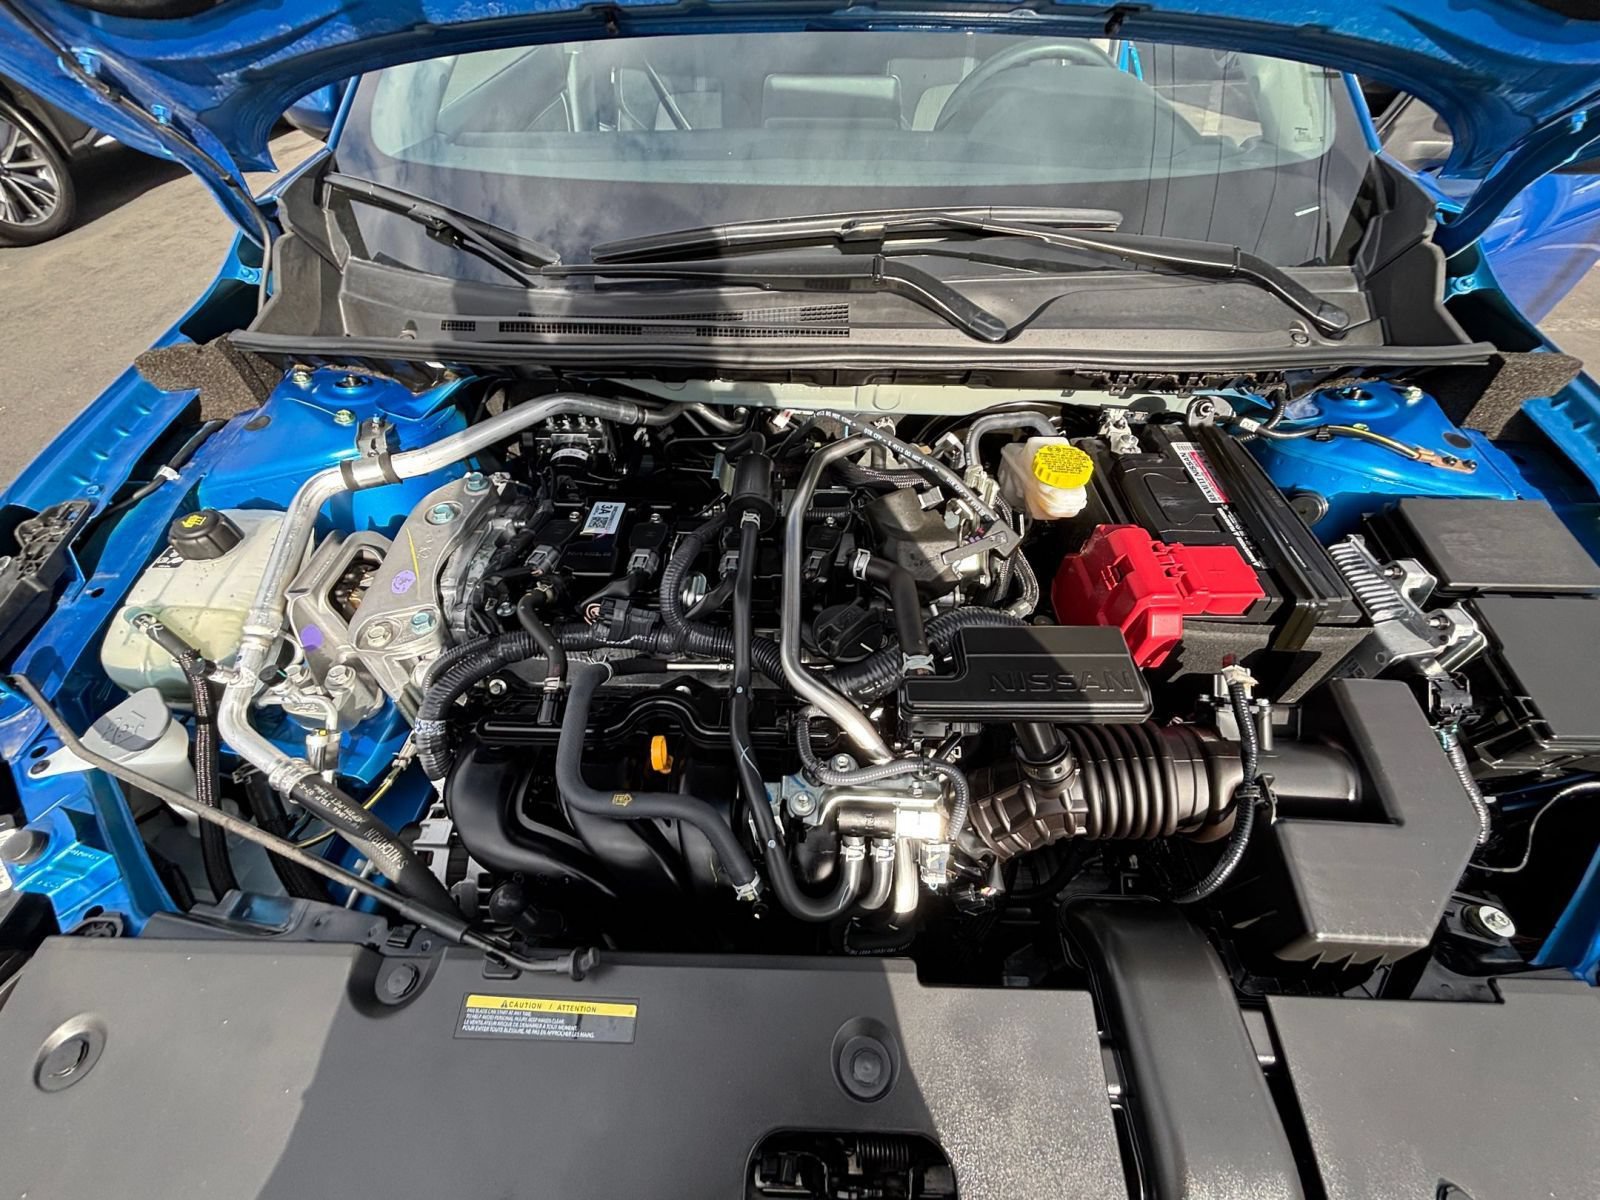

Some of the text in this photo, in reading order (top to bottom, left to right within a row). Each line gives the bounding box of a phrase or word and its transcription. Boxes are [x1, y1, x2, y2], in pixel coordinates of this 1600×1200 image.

[1180, 452, 1200, 477] NISSAN
[598, 504, 613, 515] 3A
[989, 671, 1134, 692] NISSAN
[509, 1001, 542, 1010] CAUTION
[557, 1004, 597, 1013] ATTENTION
